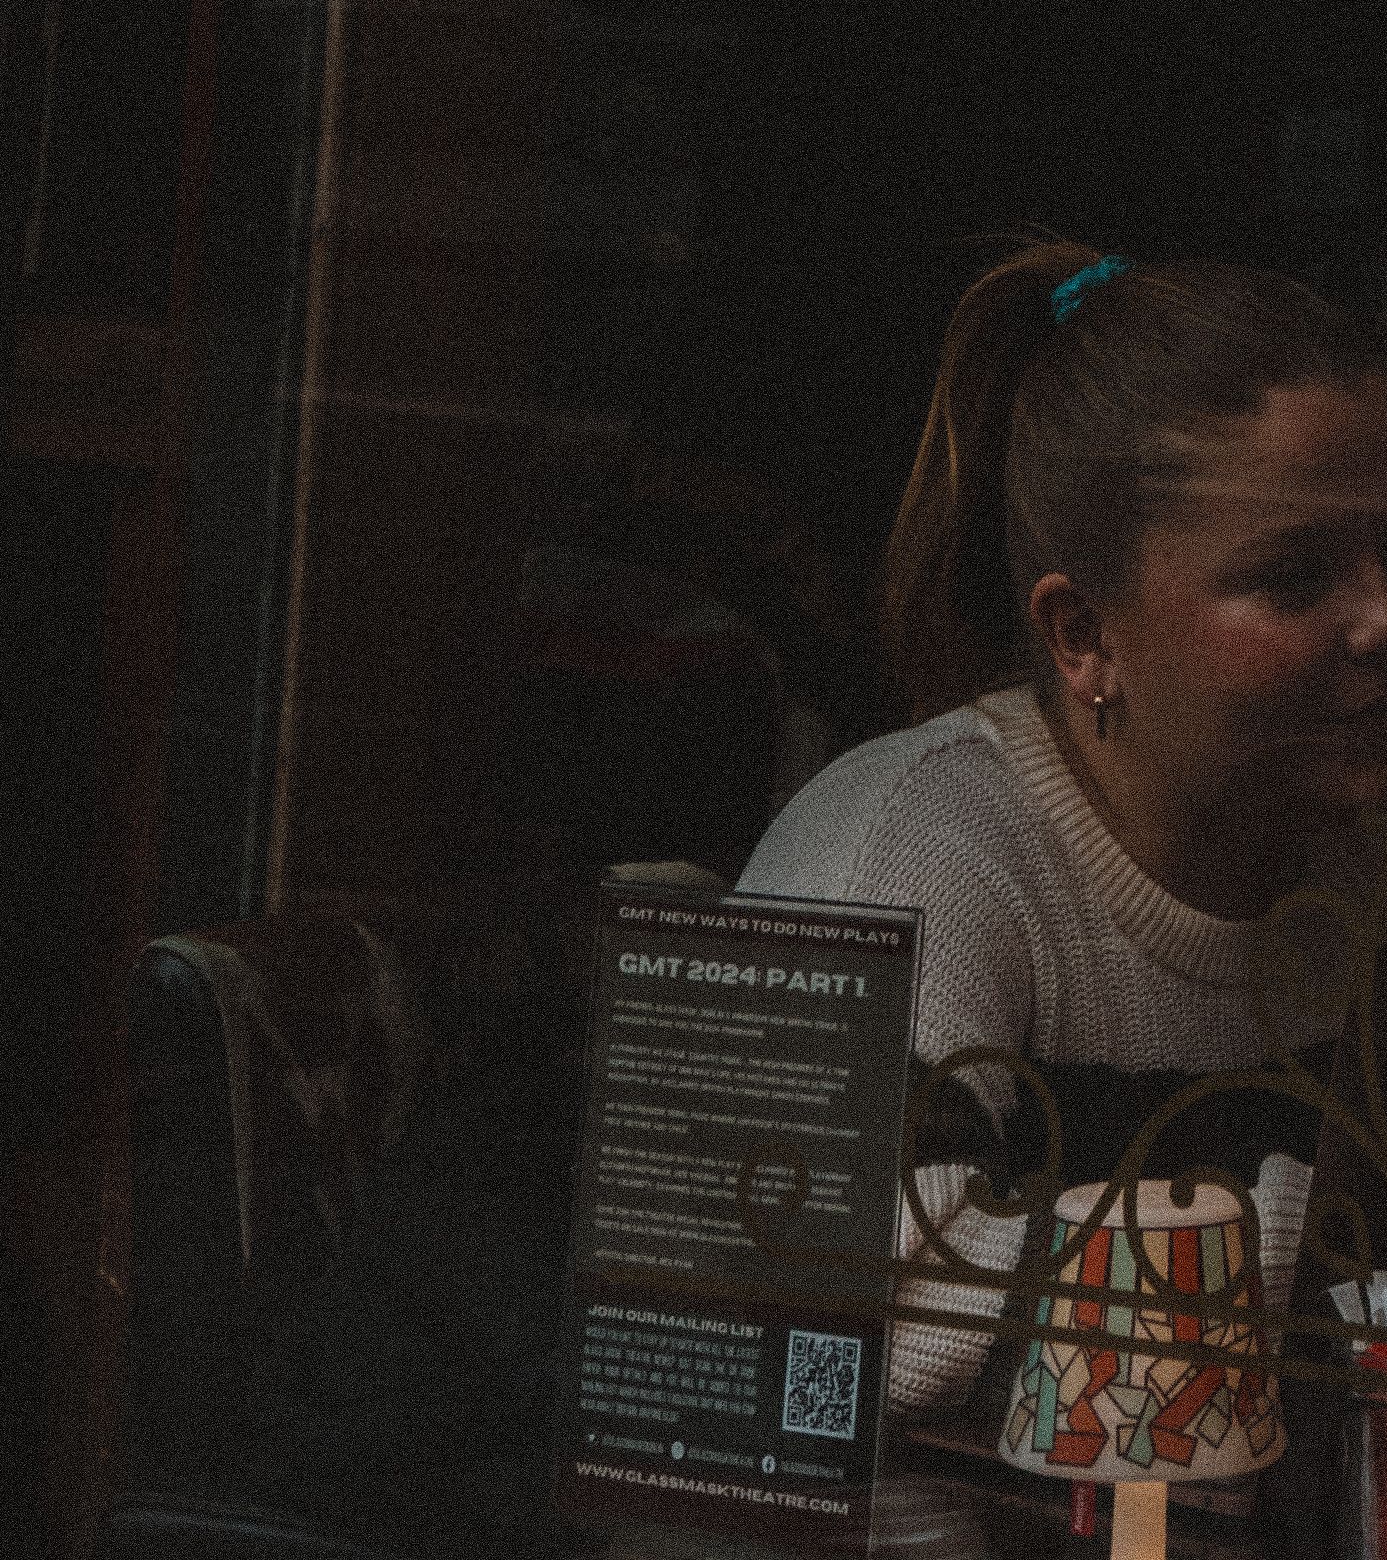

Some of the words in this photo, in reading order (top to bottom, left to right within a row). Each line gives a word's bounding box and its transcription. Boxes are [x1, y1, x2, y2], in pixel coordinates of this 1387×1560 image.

[619, 906, 655, 920] GMT
[659, 910, 697, 926] NEW
[700, 915, 748, 931] WAYS
[752, 919, 772, 933] TO
[774, 922, 797, 935] DO
[800, 925, 840, 940] NEW
[843, 928, 900, 946] PLAYS
[619, 952, 683, 978] GMT
[766, 968, 849, 995] PART
[587, 1304, 624, 1319] JOIN
[626, 1308, 657, 1325] OUR
[660, 1313, 728, 1333] MAILING
[731, 1323, 765, 1338] LIST
[576, 1462, 850, 1516] WWW.GLASSMASKTHEATRE.COM
